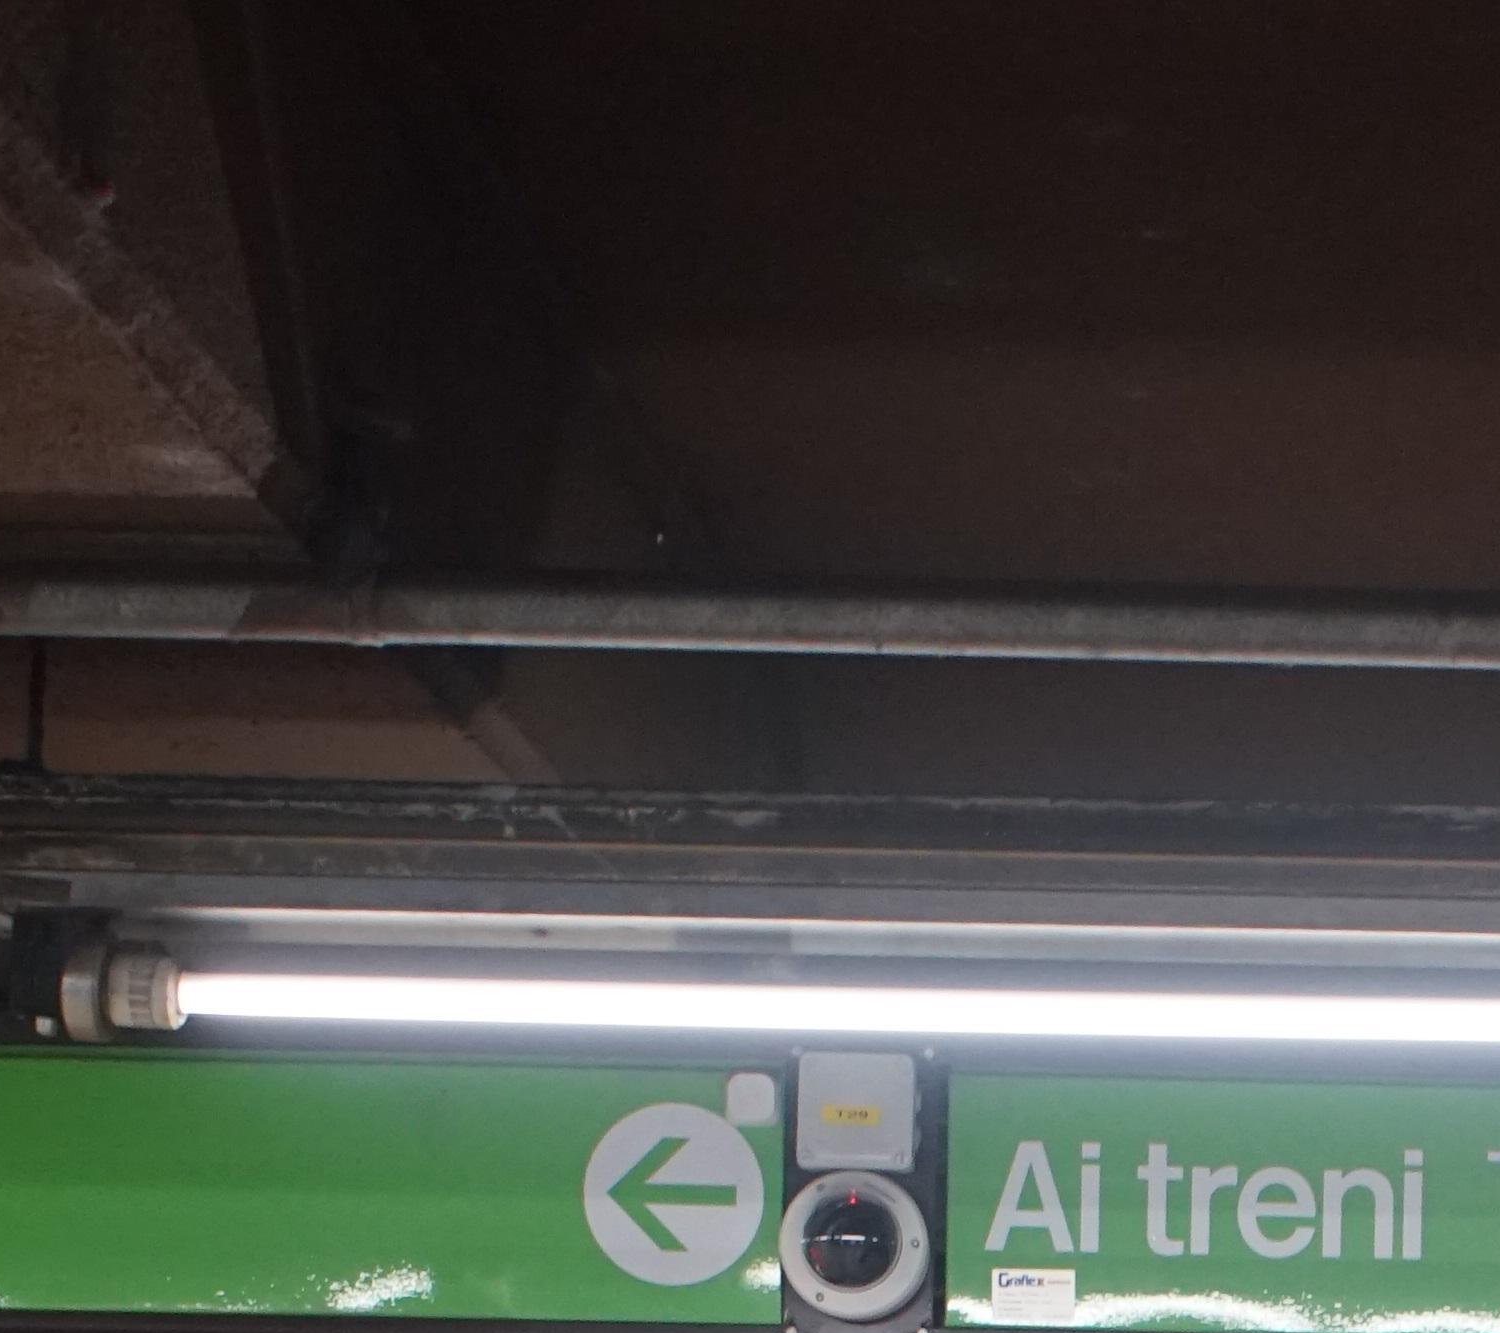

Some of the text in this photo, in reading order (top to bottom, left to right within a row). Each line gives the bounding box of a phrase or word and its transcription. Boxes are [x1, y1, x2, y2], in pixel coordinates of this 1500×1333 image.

[985, 1140, 1102, 1253] Ai
[1136, 1142, 1424, 1261] treni
[999, 1272, 1045, 1288] Graflex
